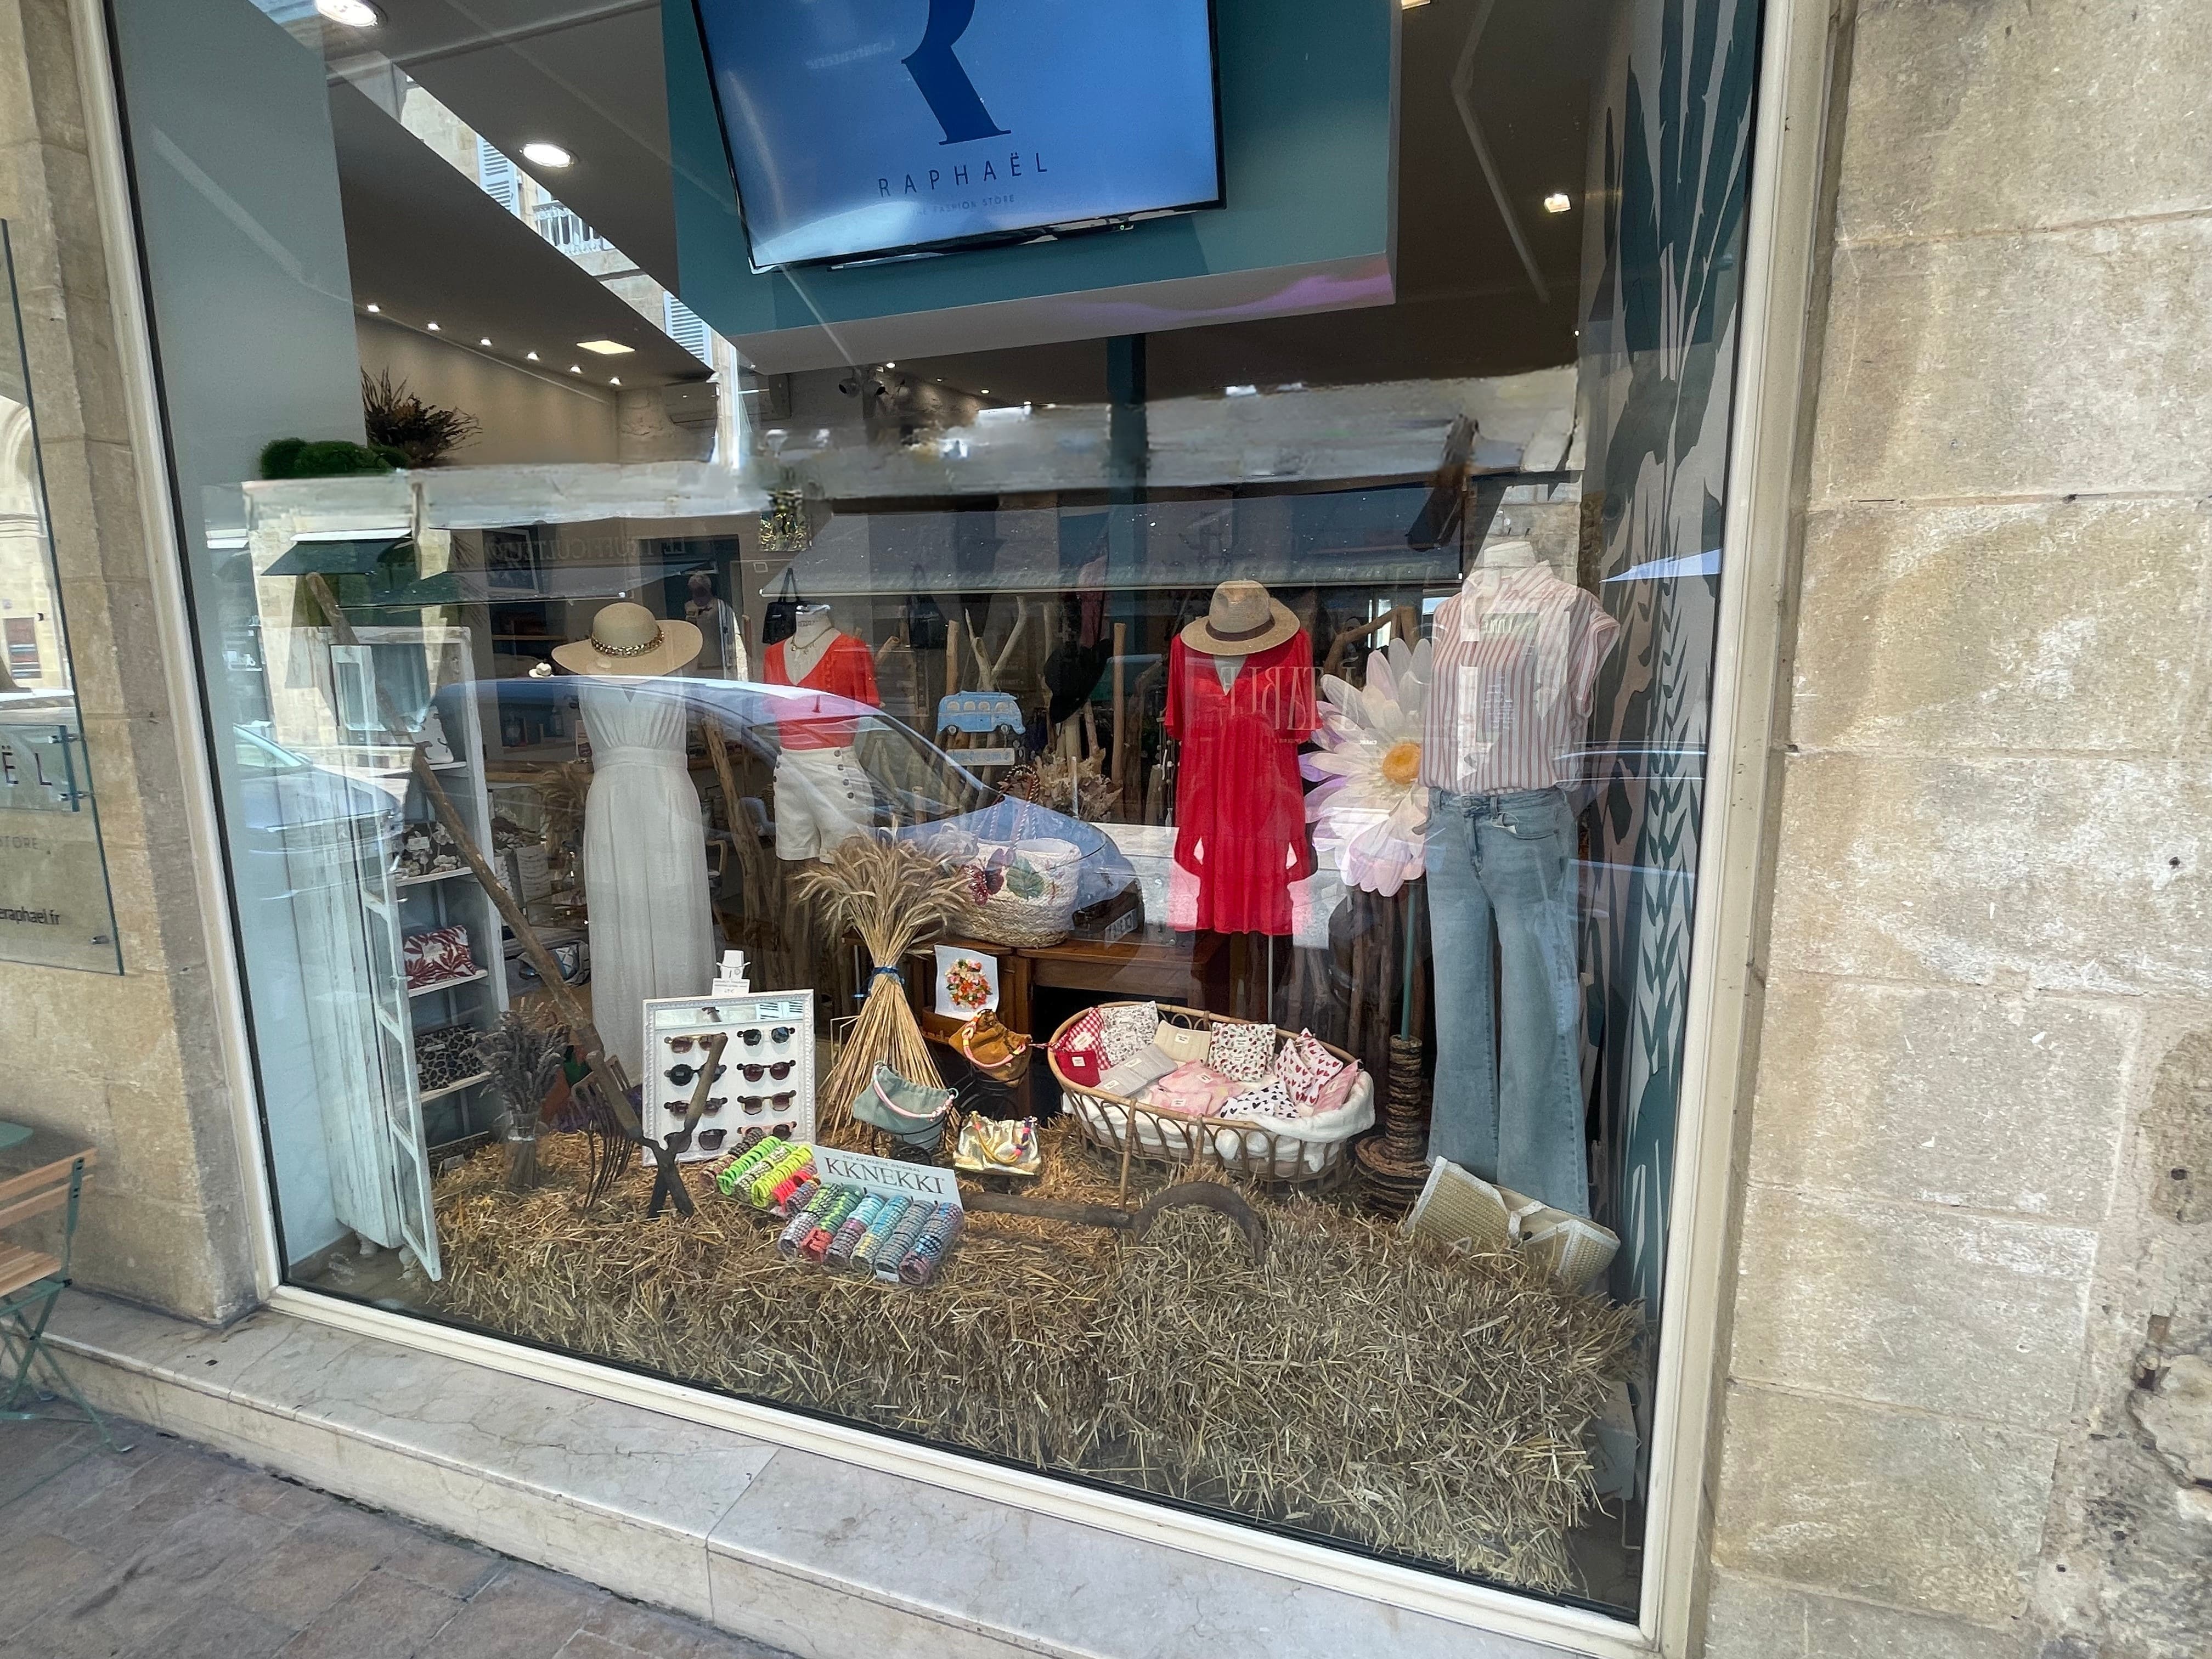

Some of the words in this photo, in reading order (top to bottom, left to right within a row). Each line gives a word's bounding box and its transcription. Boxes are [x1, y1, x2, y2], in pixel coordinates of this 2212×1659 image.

[878, 152, 1047, 198] RAPHAËL
[933, 201, 977, 213] FASHION
[982, 194, 1015, 207] STORE
[824, 1156, 944, 1195] KKNEKKI
